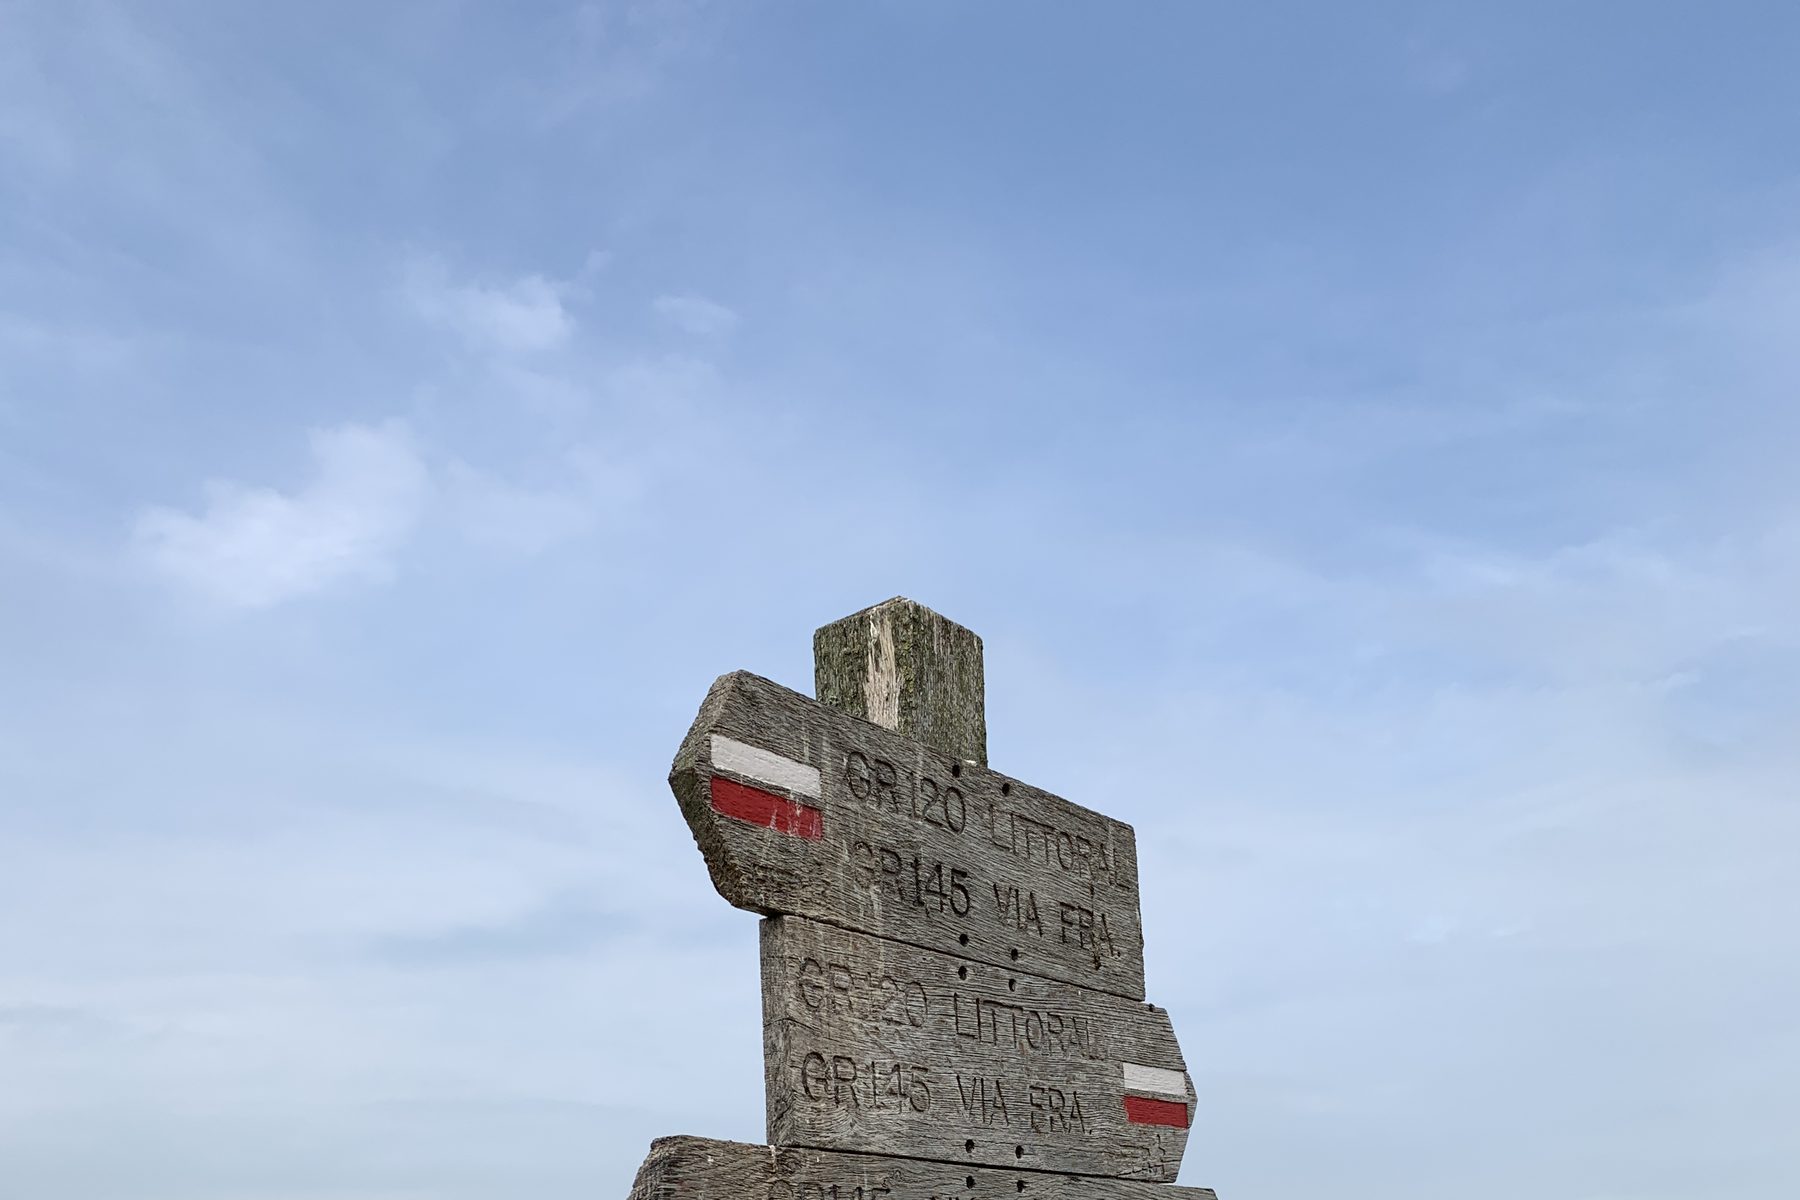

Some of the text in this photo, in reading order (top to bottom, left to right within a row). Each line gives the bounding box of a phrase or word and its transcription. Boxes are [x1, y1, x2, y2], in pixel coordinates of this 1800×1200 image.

[848, 751, 966, 835] GR120
[992, 883, 1043, 937] VIA
[801, 1051, 931, 1112] GR145
[956, 1075, 1010, 1127] VIA
